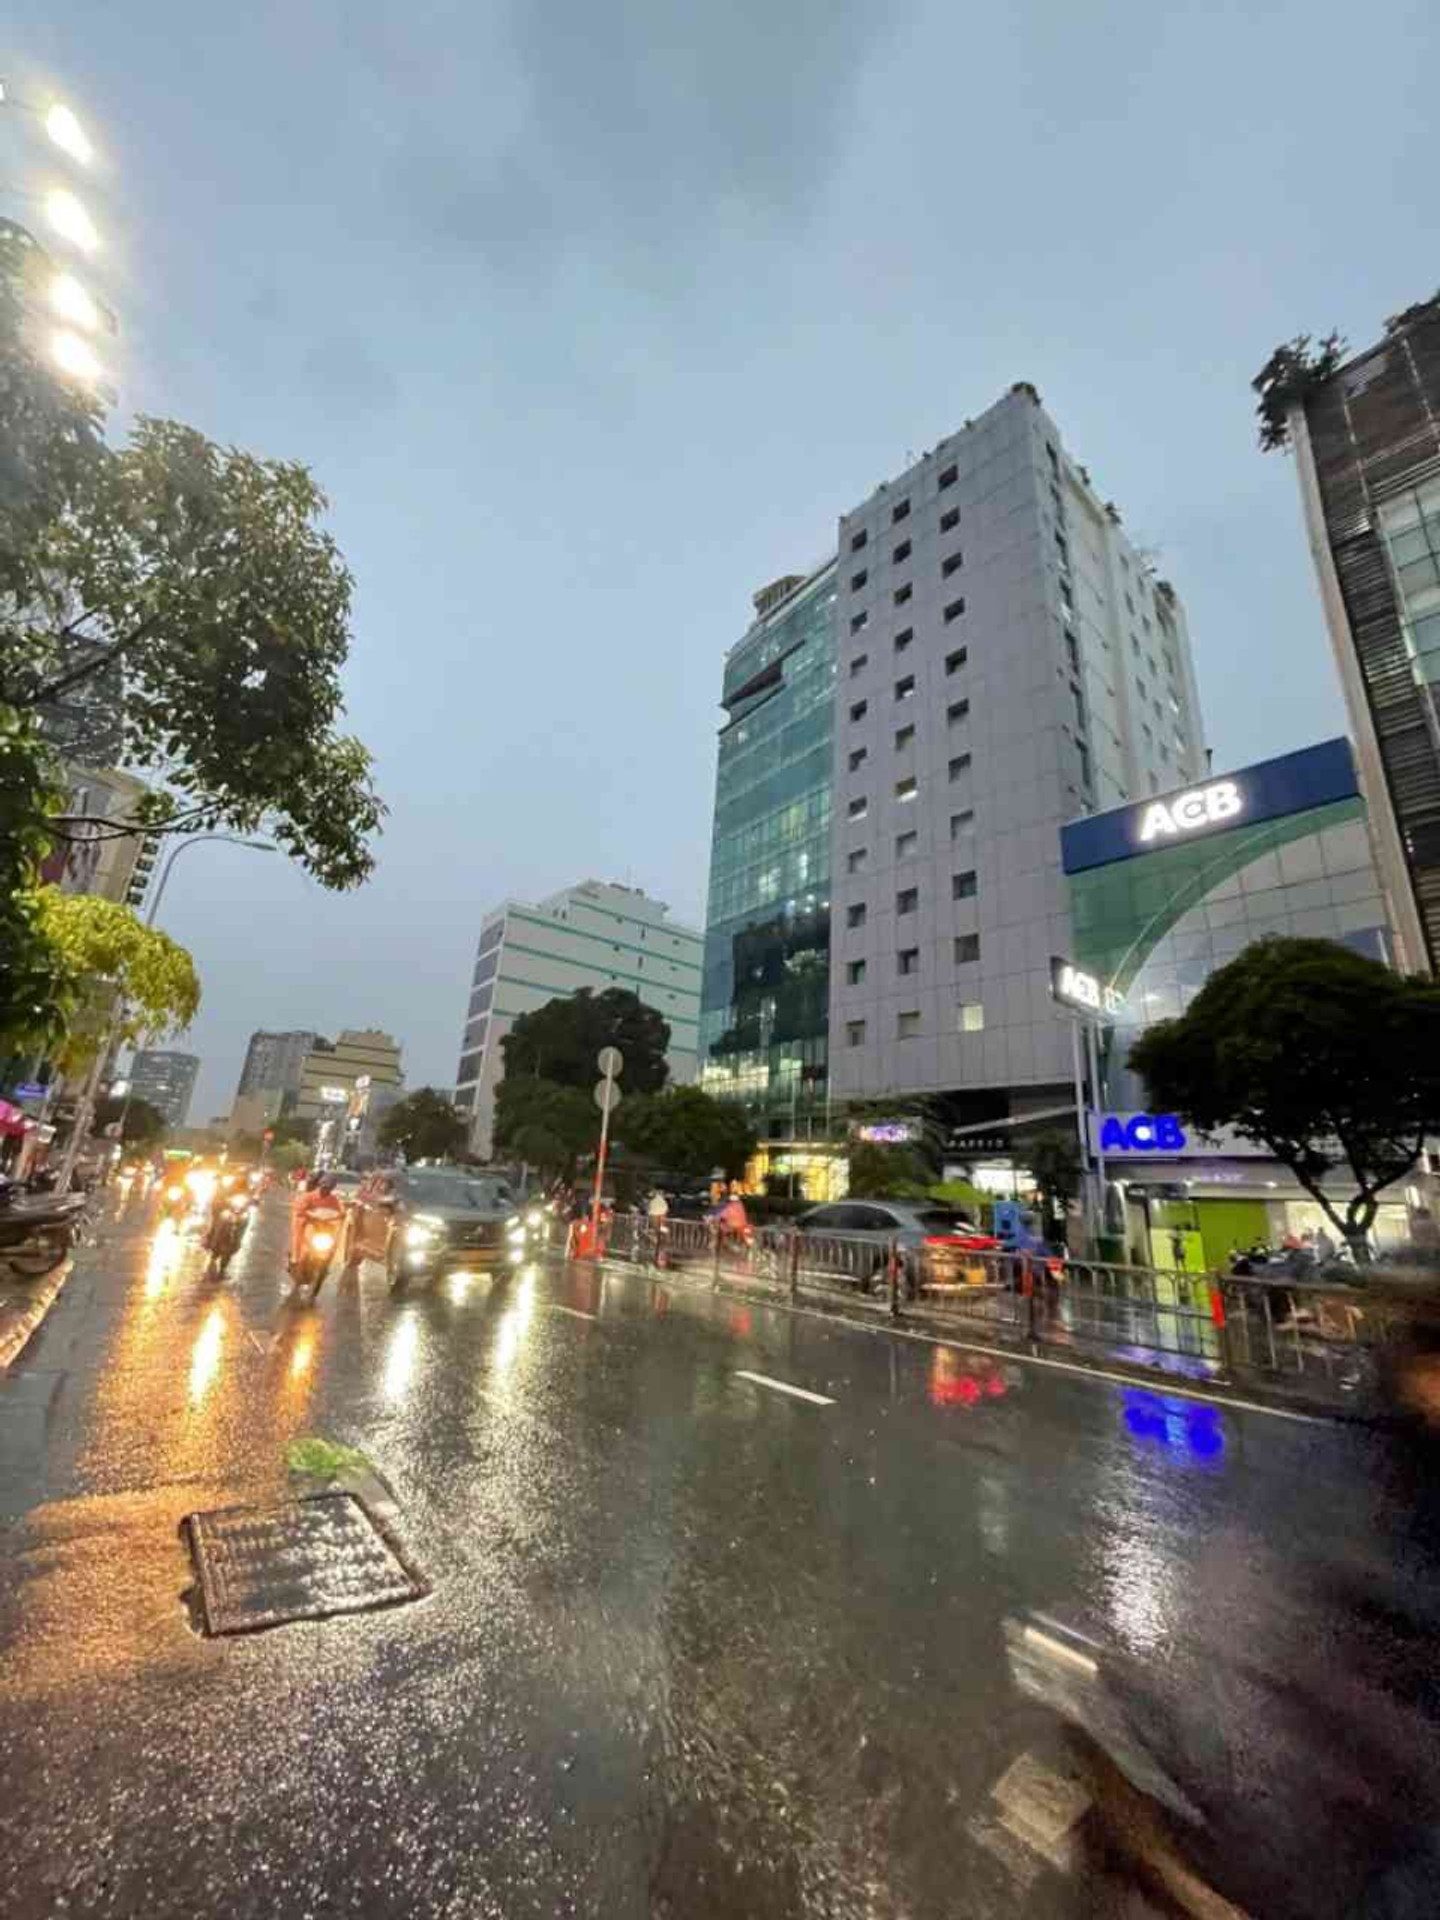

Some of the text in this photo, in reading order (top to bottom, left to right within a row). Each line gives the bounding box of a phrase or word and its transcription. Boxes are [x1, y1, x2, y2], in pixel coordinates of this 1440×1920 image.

[1139, 782, 1242, 841] ACB
[1059, 965, 1100, 1007] ACB
[1101, 1114, 1186, 1150] ACB
